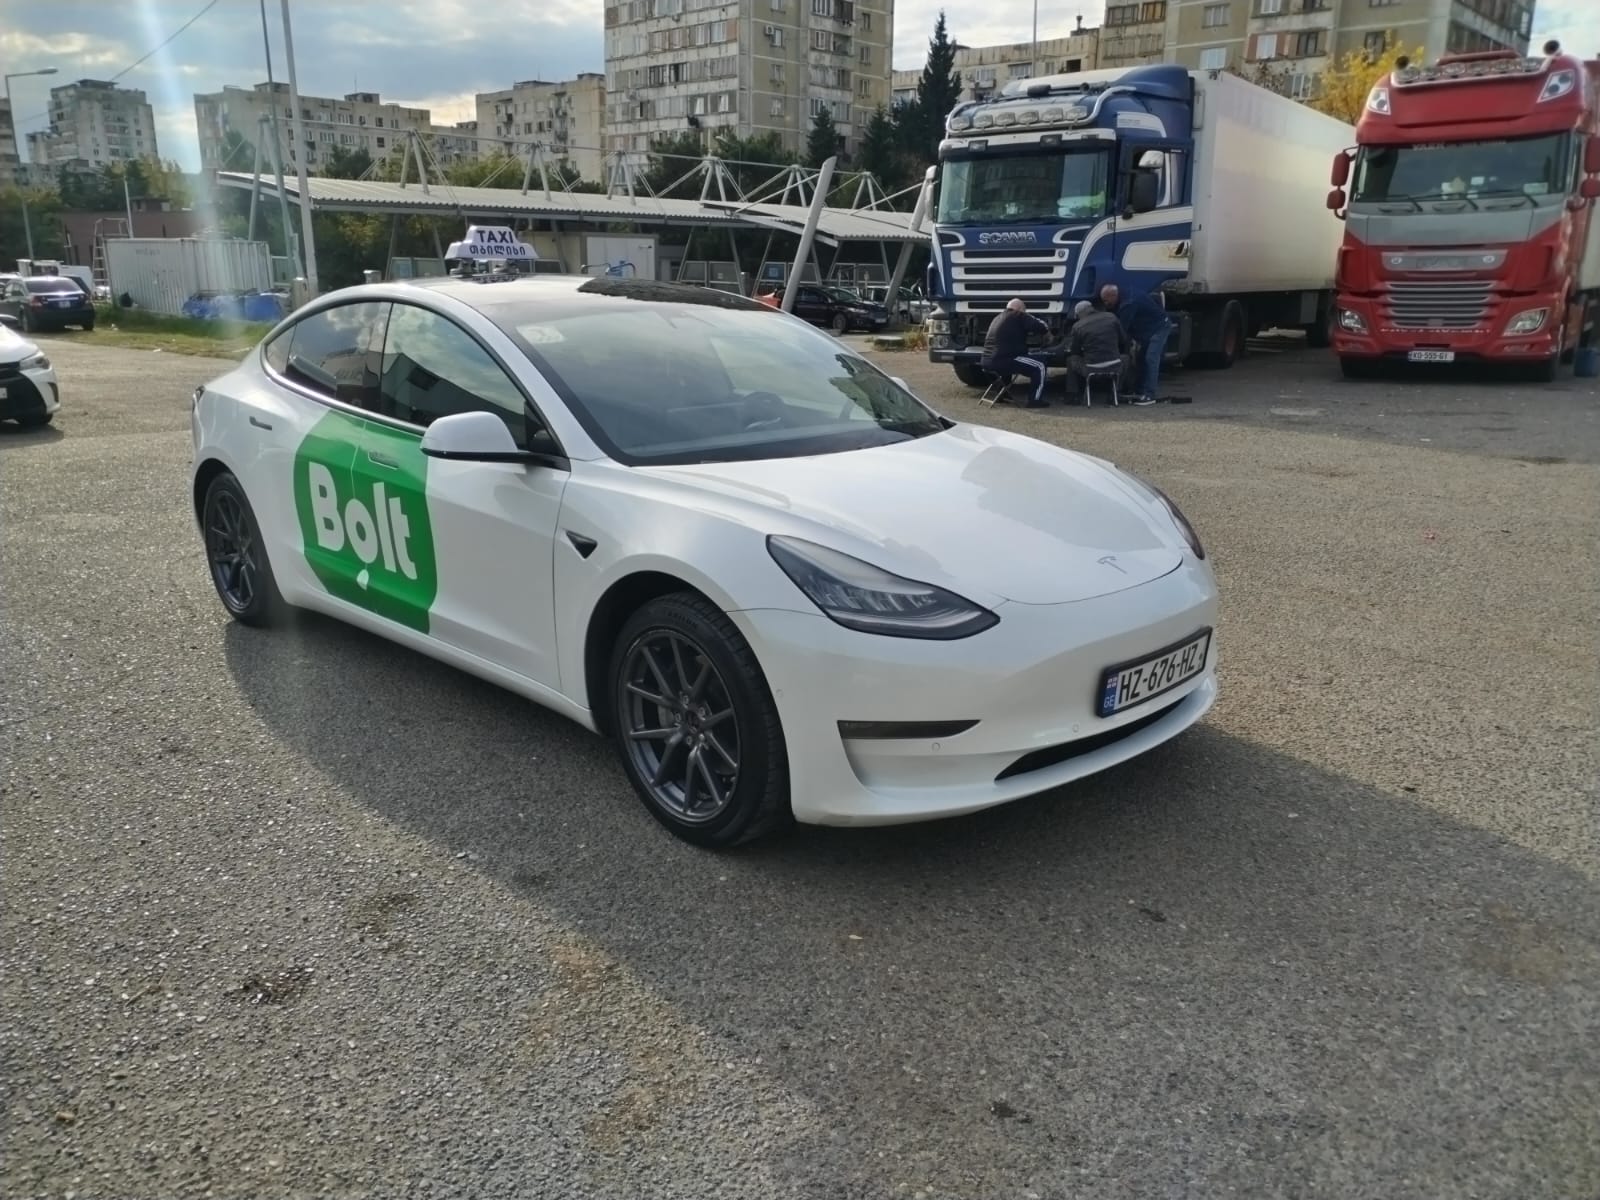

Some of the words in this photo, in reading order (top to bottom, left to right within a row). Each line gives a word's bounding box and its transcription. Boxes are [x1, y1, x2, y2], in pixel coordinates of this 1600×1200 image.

[477, 230, 514, 244] TAXI
[979, 231, 1038, 245] SCANIA
[469, 244, 526, 256] თბილისი
[308, 461, 418, 581] Bolt
[1118, 643, 1198, 704] HZ-676-HZ
[1103, 695, 1115, 709] GE
